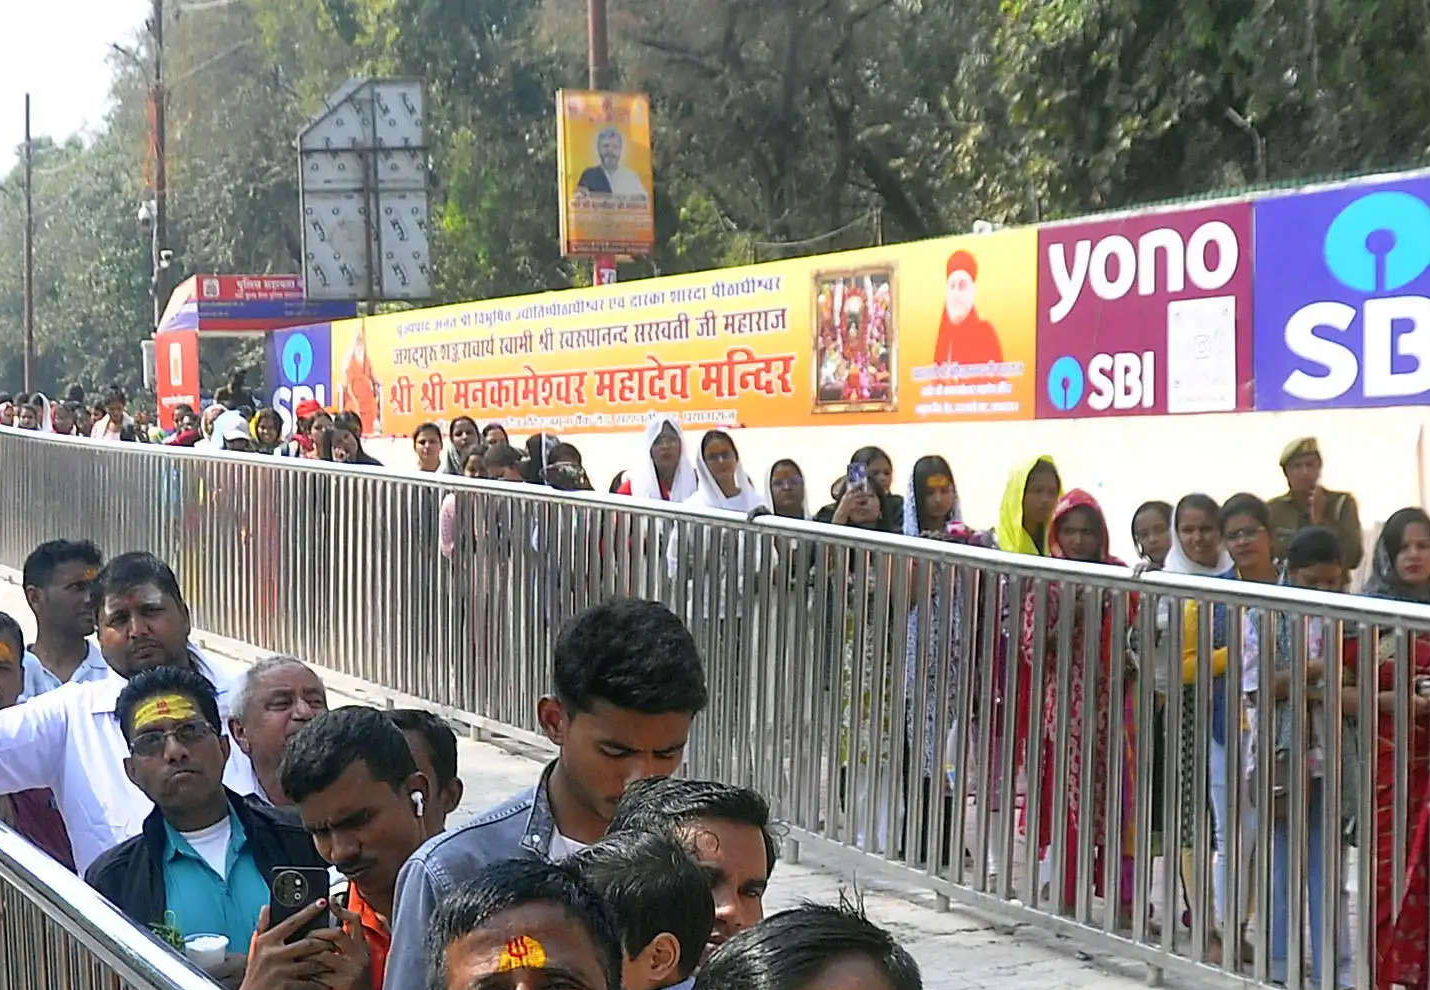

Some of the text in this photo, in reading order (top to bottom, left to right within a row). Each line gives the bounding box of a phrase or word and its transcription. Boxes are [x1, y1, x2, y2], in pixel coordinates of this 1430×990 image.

[1047, 220, 1240, 324] yono
[499, 328, 533, 355] स्वामी
[539, 326, 554, 351] श्री
[634, 312, 689, 343] सरस्वती
[696, 310, 717, 337] जी
[723, 308, 787, 335] महाराज
[389, 348, 795, 413] श्री श्री मनकामेश्वर महादेव मन्दिर
[1087, 350, 1156, 410] SBI
